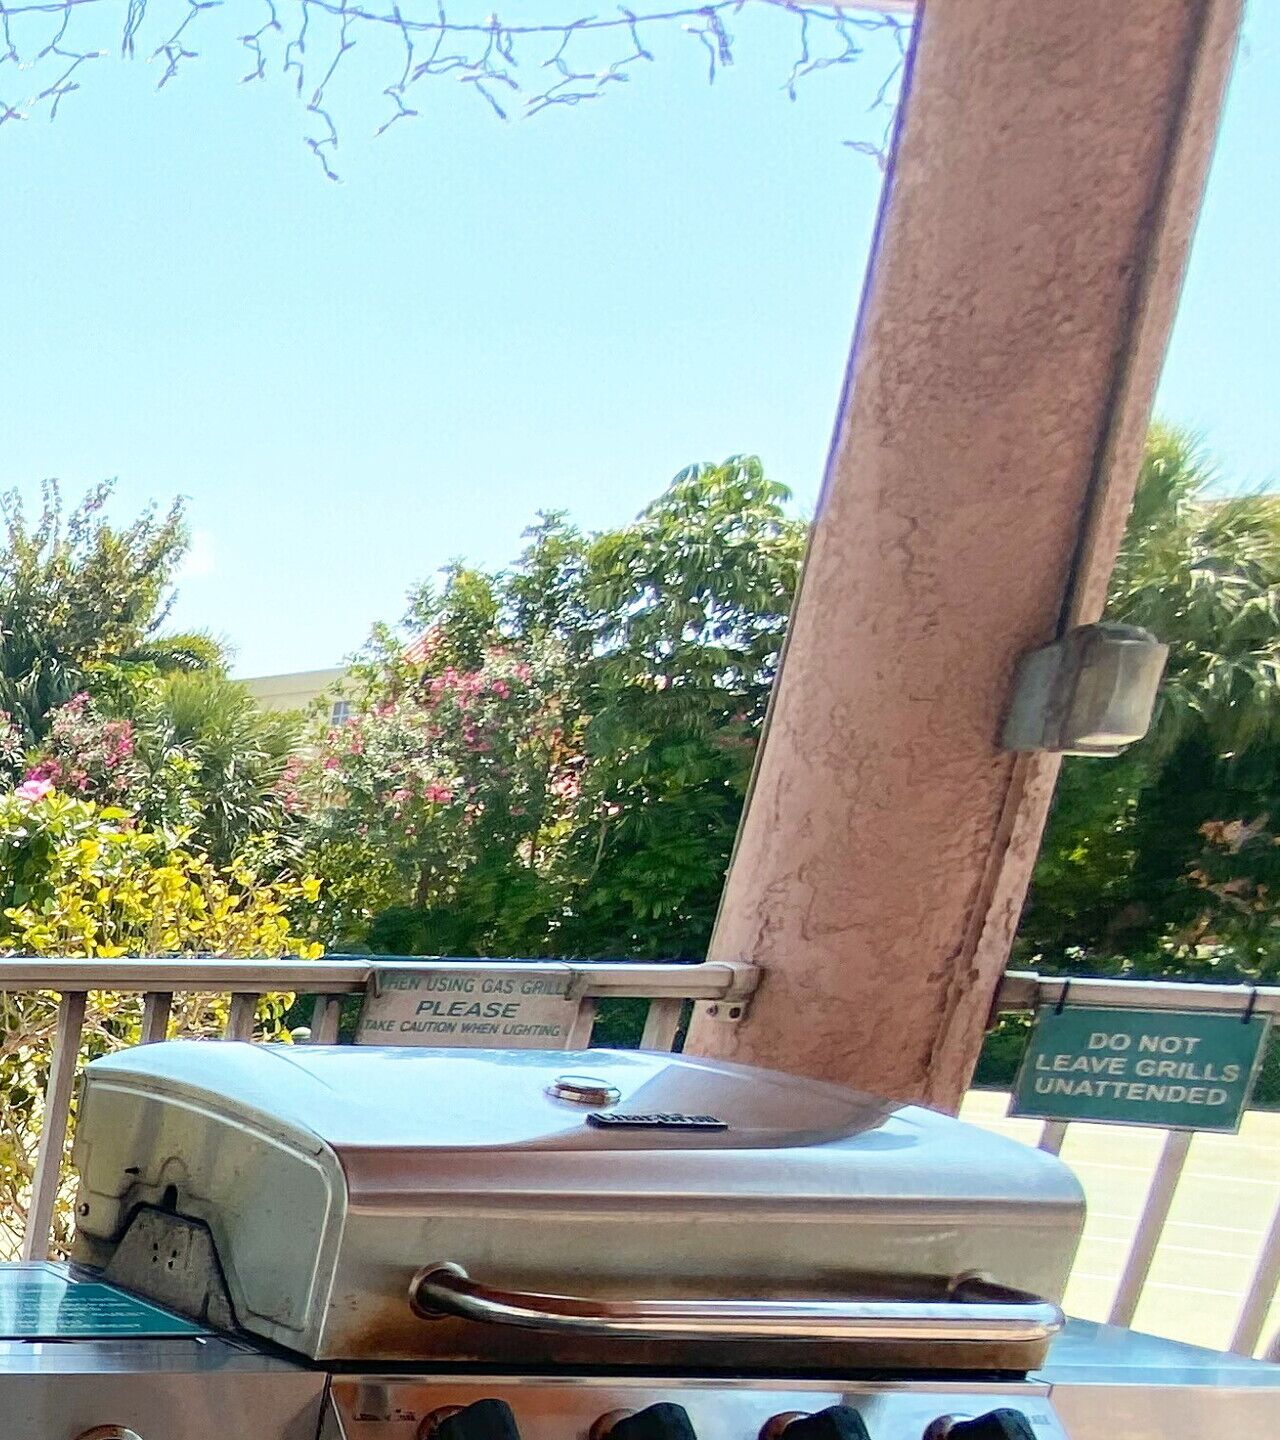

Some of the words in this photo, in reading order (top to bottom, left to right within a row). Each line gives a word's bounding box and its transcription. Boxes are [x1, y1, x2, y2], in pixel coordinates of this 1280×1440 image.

[426, 977, 475, 993] USING
[482, 979, 514, 994] GAS
[521, 980, 573, 996] GRILL
[416, 1000, 520, 1018] PLEASE
[365, 1020, 396, 1031] TAKE
[400, 1021, 456, 1033] CAUTION
[460, 1023, 499, 1034] WHEN
[503, 1024, 561, 1037] LIGHTING
[1089, 1032, 1131, 1050] DO
[1138, 1035, 1201, 1055] NOT
[1035, 1053, 1128, 1075] LEAVE
[1135, 1059, 1240, 1083] GRILLS
[1035, 1078, 1228, 1106] UNATTENDED
